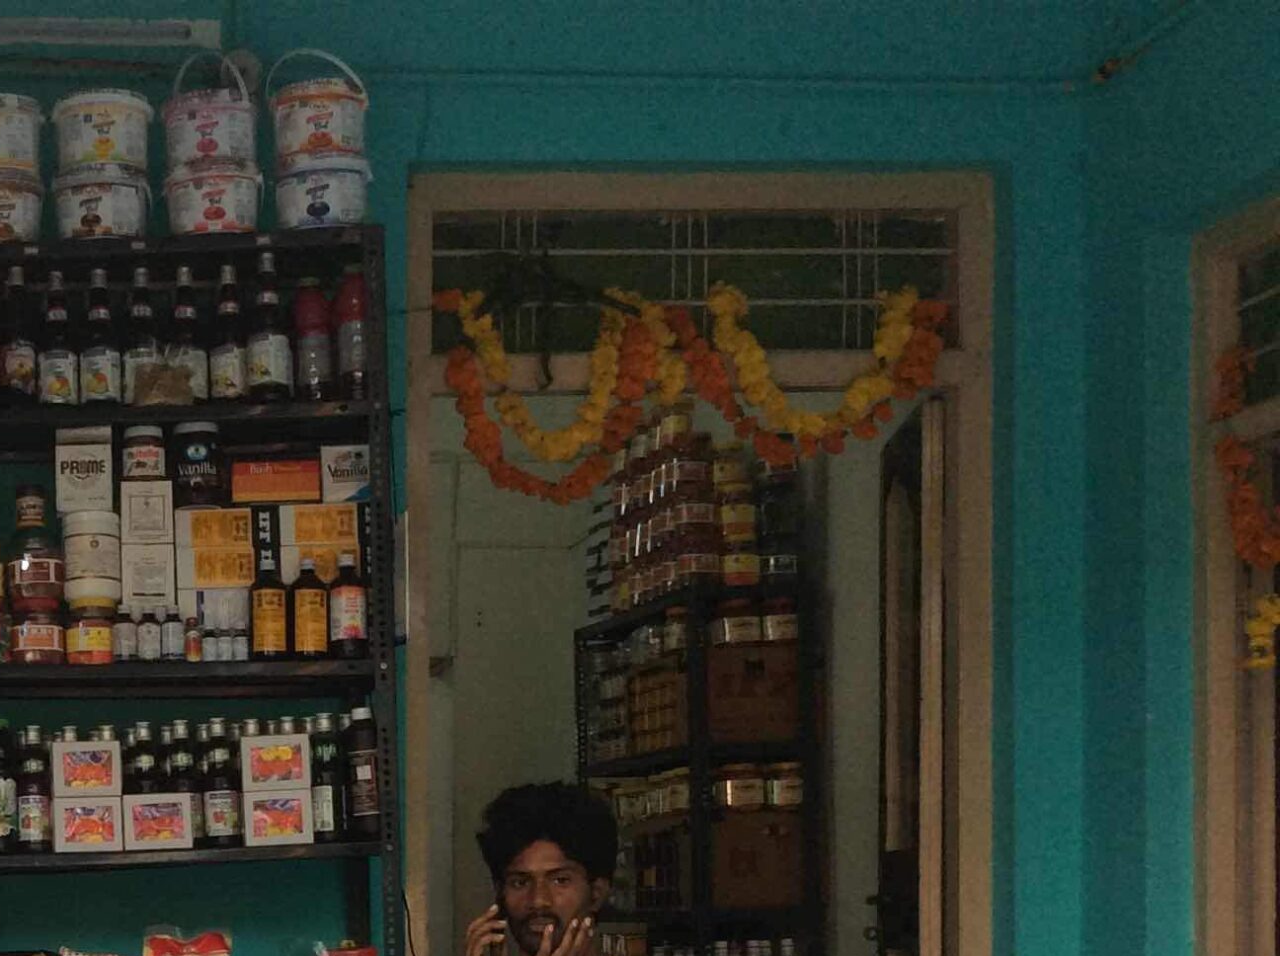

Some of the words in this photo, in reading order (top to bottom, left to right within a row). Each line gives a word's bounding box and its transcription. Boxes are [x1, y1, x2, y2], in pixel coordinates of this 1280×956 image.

[60, 460, 106, 475] PRIME
[177, 460, 217, 475] Vanilla
[327, 463, 368, 479] Vanilla
